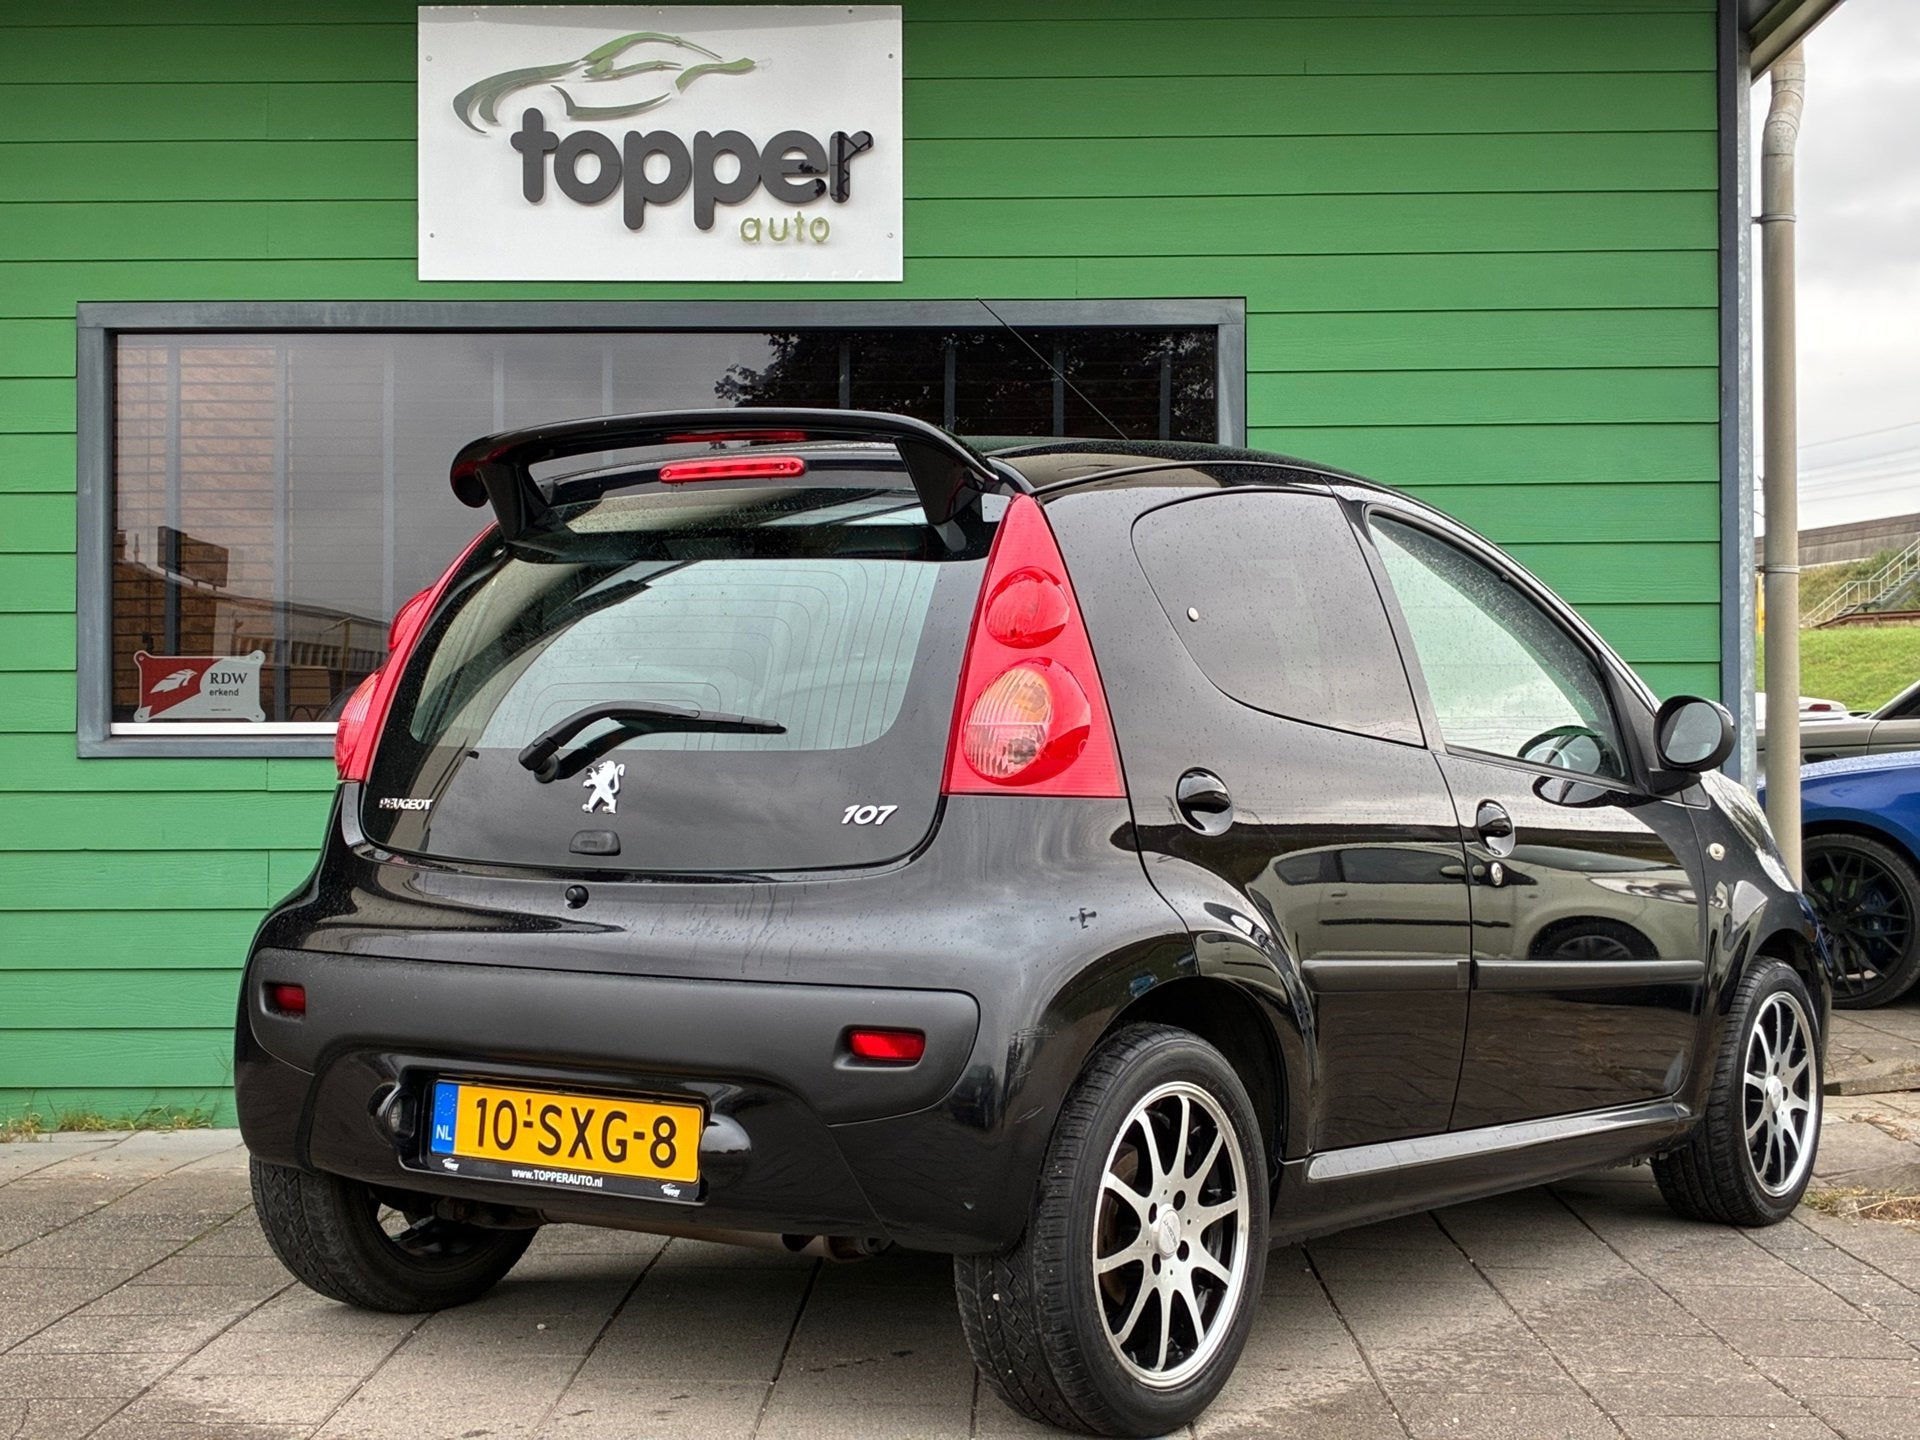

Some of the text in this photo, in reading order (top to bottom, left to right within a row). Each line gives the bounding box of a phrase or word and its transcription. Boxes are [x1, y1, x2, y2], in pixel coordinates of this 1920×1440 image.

[510, 107, 874, 230] topper
[740, 211, 830, 243] auto
[209, 672, 248, 685] RDW
[209, 688, 239, 697] erkend
[379, 798, 433, 810] PEUGEOT
[841, 804, 898, 825] 107
[435, 1124, 452, 1140] NL
[475, 1097, 677, 1169] 10-SXG-8
[511, 1169, 603, 1187] www.TOPPERAUTO.nl
